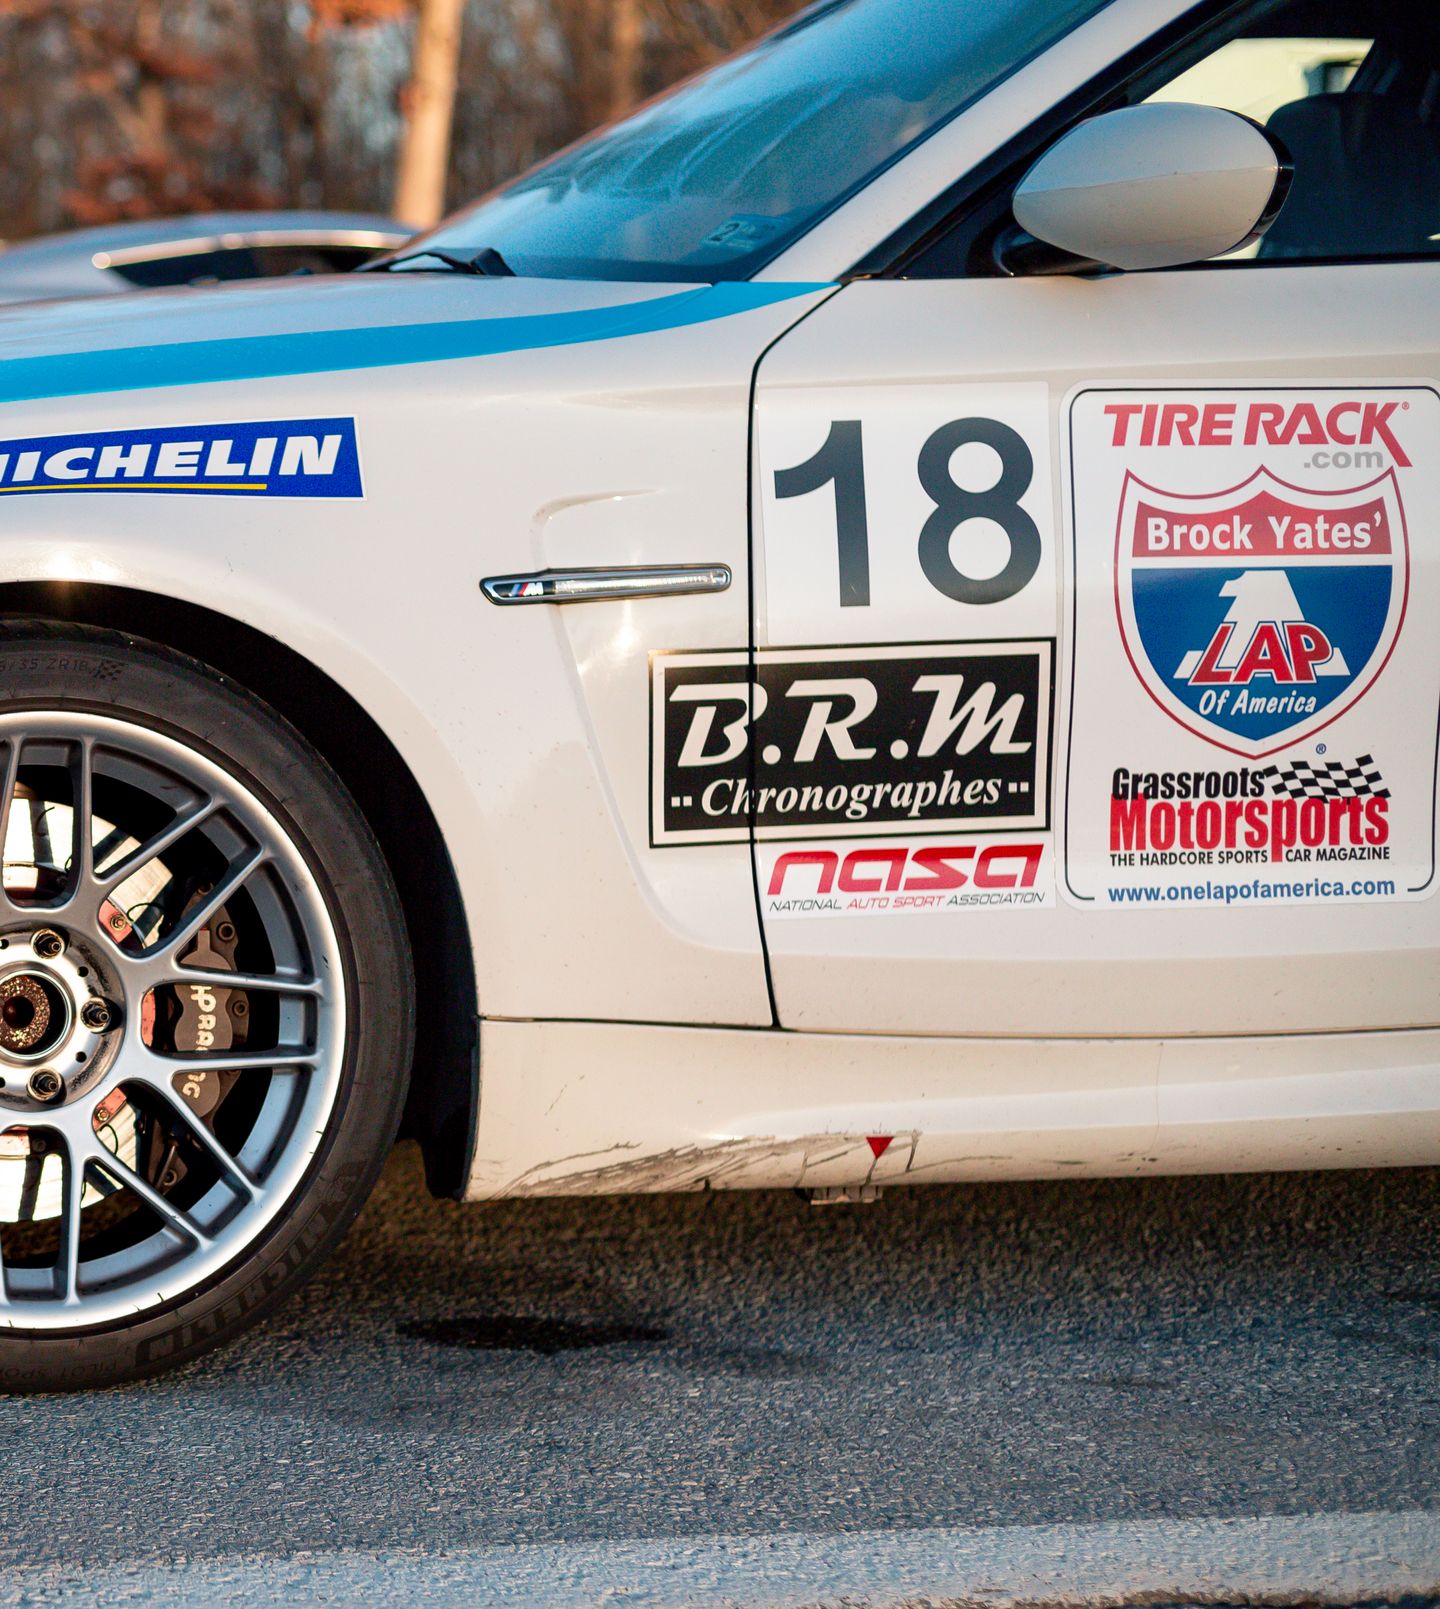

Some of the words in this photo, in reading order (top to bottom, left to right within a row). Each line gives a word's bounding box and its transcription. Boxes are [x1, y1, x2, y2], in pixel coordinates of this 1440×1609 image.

[1103, 403, 1237, 446] TIRE
[1243, 401, 1413, 467] RACK
[1303, 451, 1384, 469] .com
[773, 416, 1042, 607] 18
[1147, 515, 1253, 550] Brock
[1267, 511, 1381, 549] Yates'
[1187, 621, 1335, 686] LAP
[1198, 689, 1229, 715] Of
[1230, 689, 1318, 715] America
[700, 771, 1002, 819] Chronographes
[1112, 767, 1266, 801] Grassroots
[1109, 793, 1390, 862] Motorsports
[767, 844, 1045, 895] nasa
[1110, 853, 1135, 867] THE
[1139, 851, 1214, 866] HARDCORE
[1217, 850, 1269, 865] SPORTS
[1285, 848, 1312, 863] CAR
[1315, 846, 1391, 862] MAGAZINE
[769, 899, 843, 912] NATIONAL
[846, 897, 891, 910] AUTO
[892, 895, 946, 908] SPORT
[946, 892, 1046, 907] ASSOCIATION
[1107, 878, 1396, 904] www.onelapofamerica.com
[149, 1208, 329, 1359] MICHELIN
